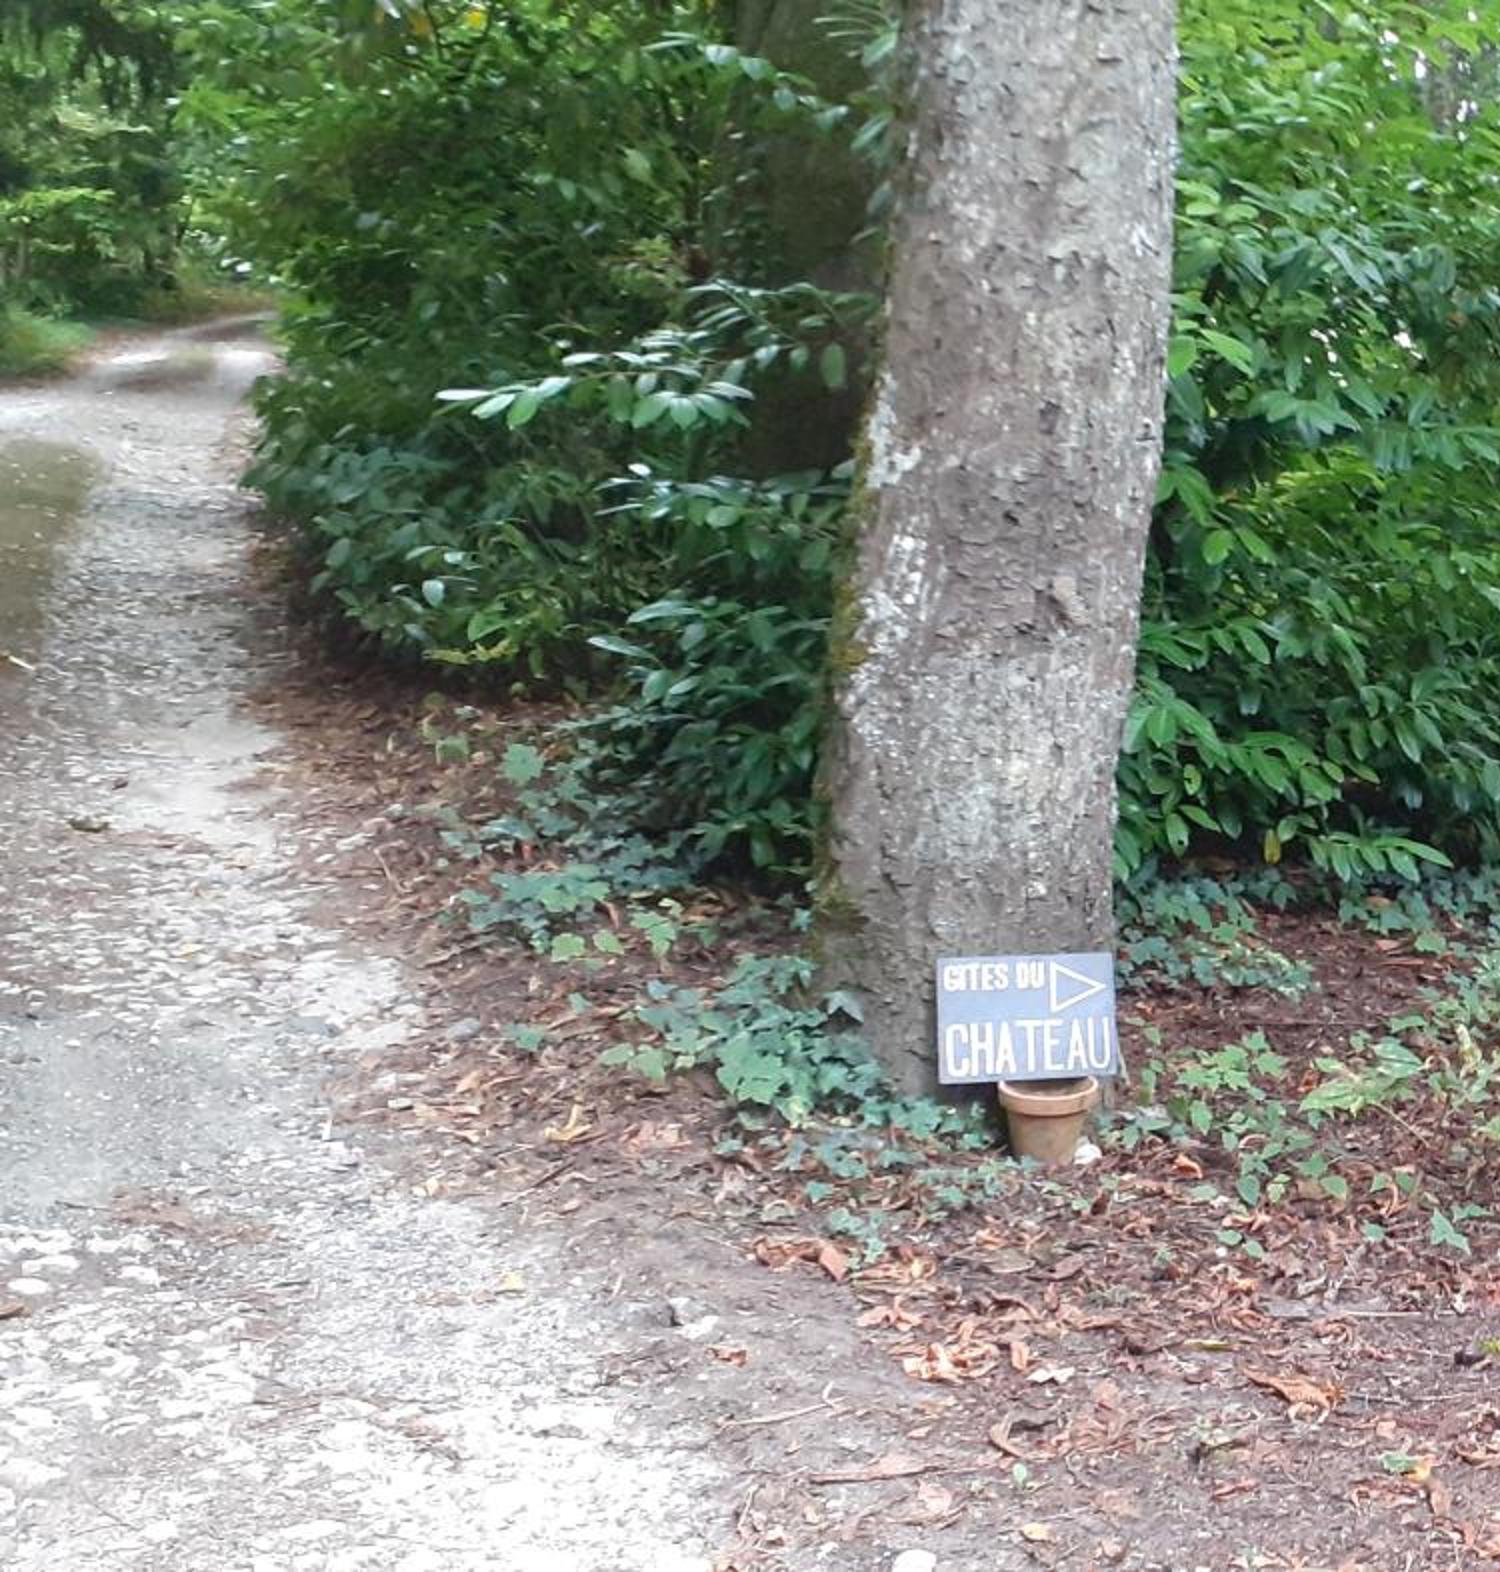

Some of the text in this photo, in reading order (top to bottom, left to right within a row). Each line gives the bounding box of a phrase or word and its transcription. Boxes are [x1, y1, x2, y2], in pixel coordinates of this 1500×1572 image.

[943, 960, 1045, 991] GITES DU
[945, 1016, 1111, 1077] CHATEAU
